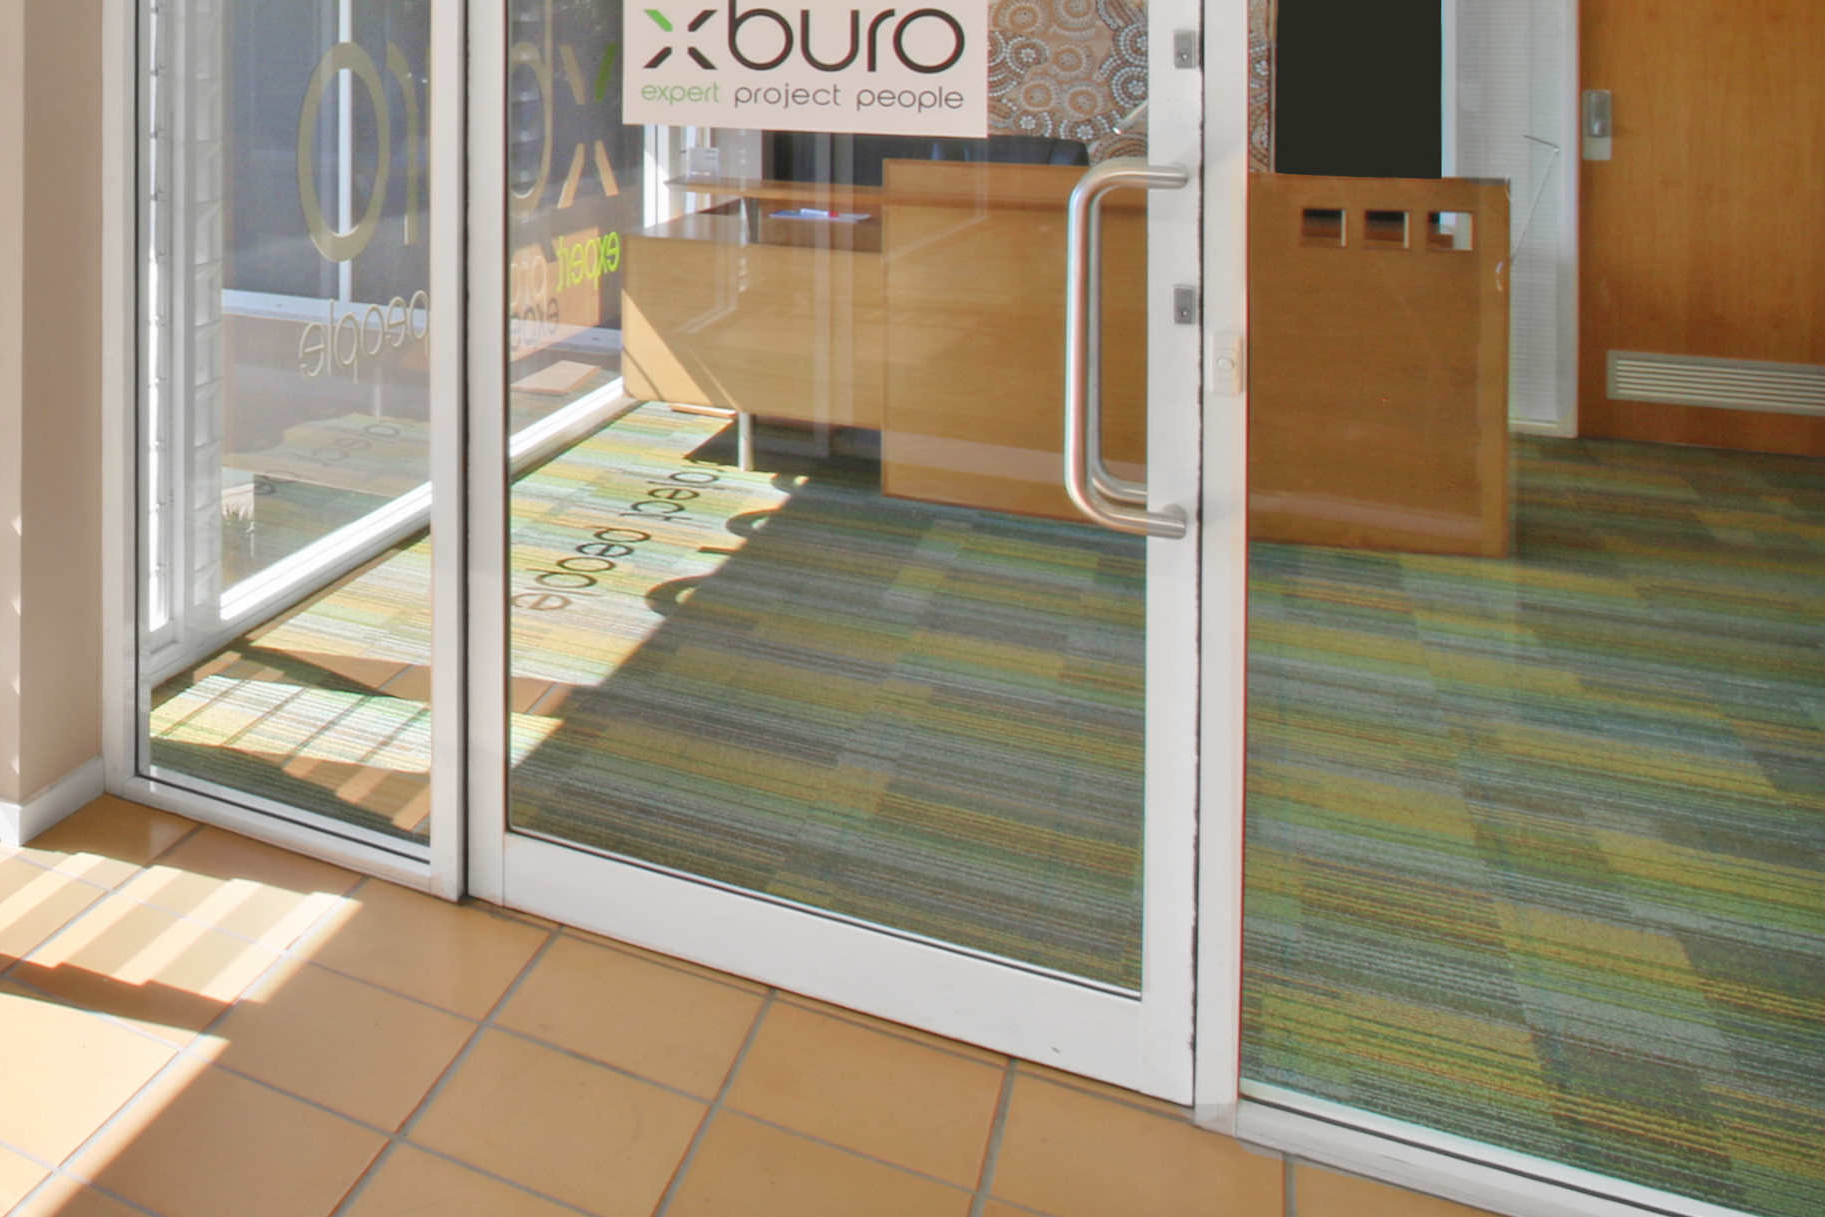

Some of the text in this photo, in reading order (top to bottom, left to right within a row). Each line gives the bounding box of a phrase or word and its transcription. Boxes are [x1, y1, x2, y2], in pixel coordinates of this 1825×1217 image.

[640, 81, 964, 113] expert project people
